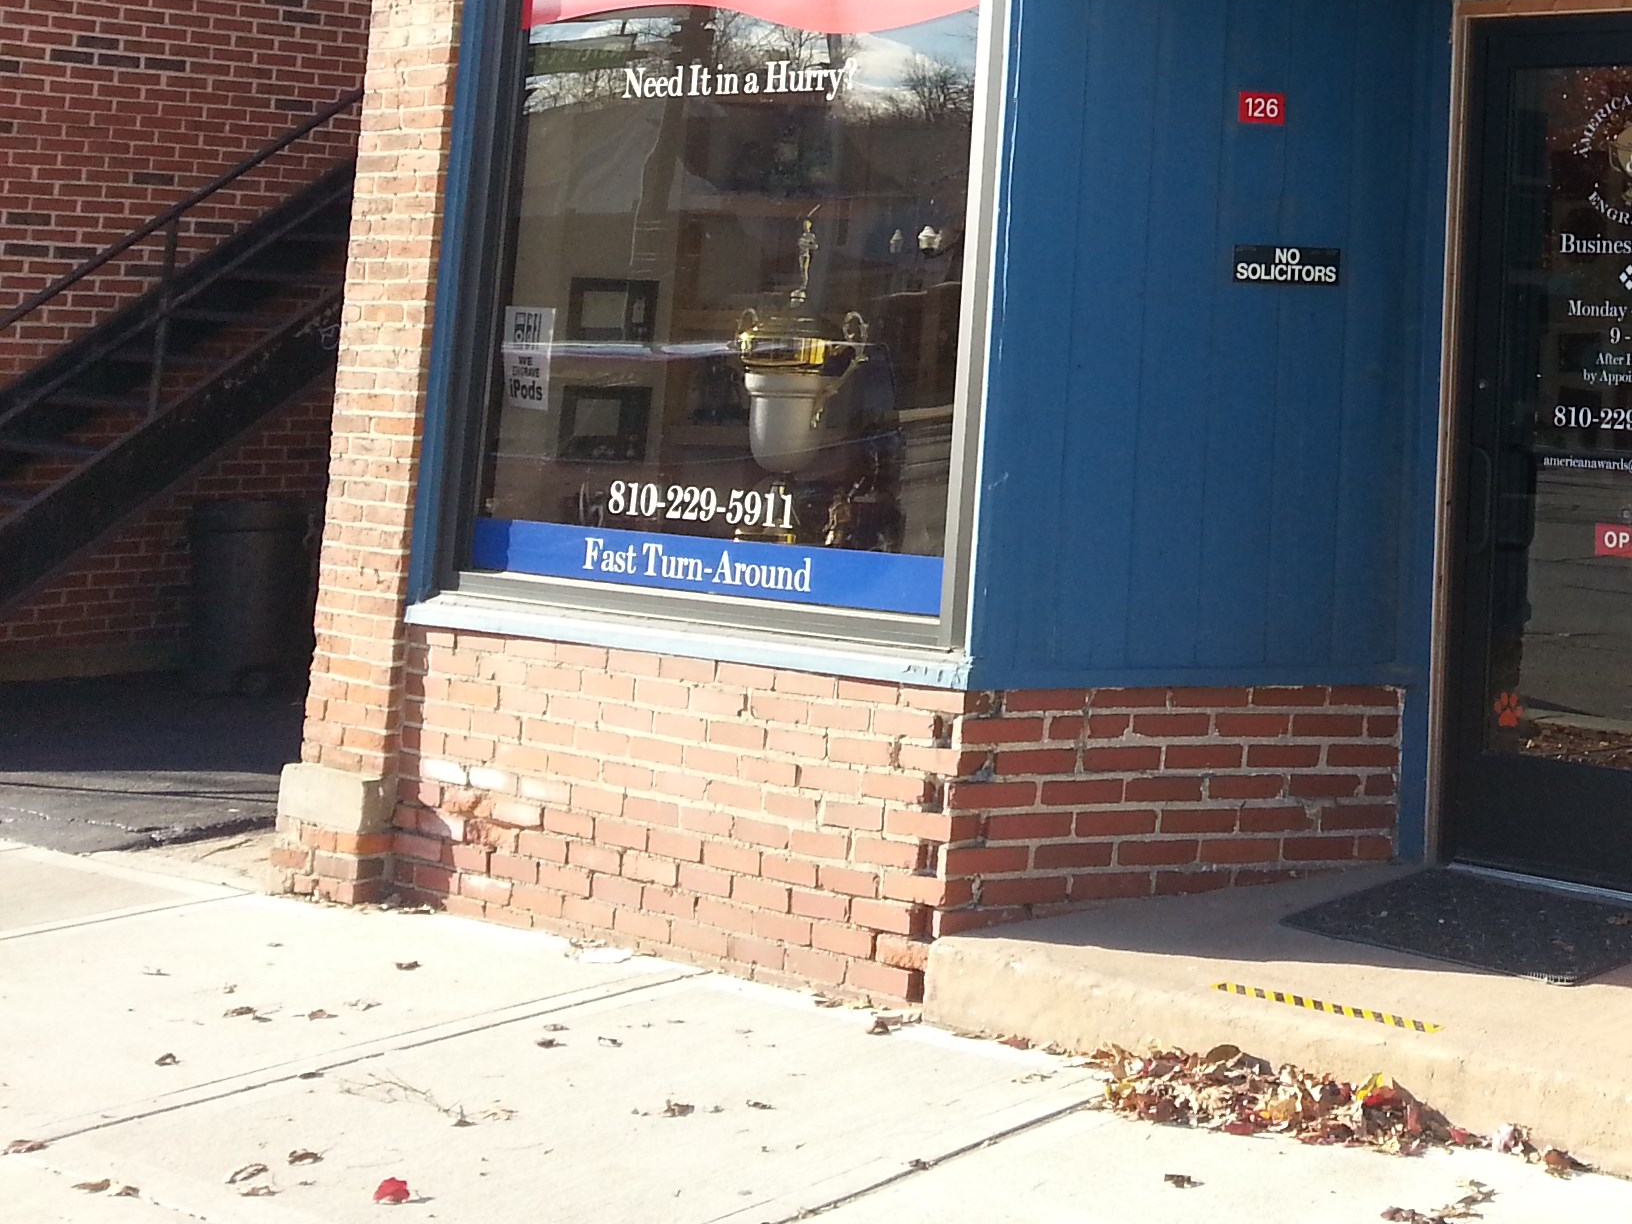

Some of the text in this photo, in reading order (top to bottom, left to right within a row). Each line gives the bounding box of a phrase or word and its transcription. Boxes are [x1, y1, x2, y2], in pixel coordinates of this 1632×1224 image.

[622, 57, 858, 102] Need It in a Hurry?
[1245, 97, 1279, 118] 126
[1274, 247, 1301, 265] NO
[1236, 264, 1337, 283] SOLICITORS
[1568, 300, 1628, 322] Monday
[1610, 327, 1621, 344] 9
[1595, 352, 1625, 365] After
[1583, 369, 1598, 384] by
[510, 378, 543, 401] iPods
[608, 480, 794, 529] 810-229-5911
[582, 537, 812, 592] Fast Turn-Around
